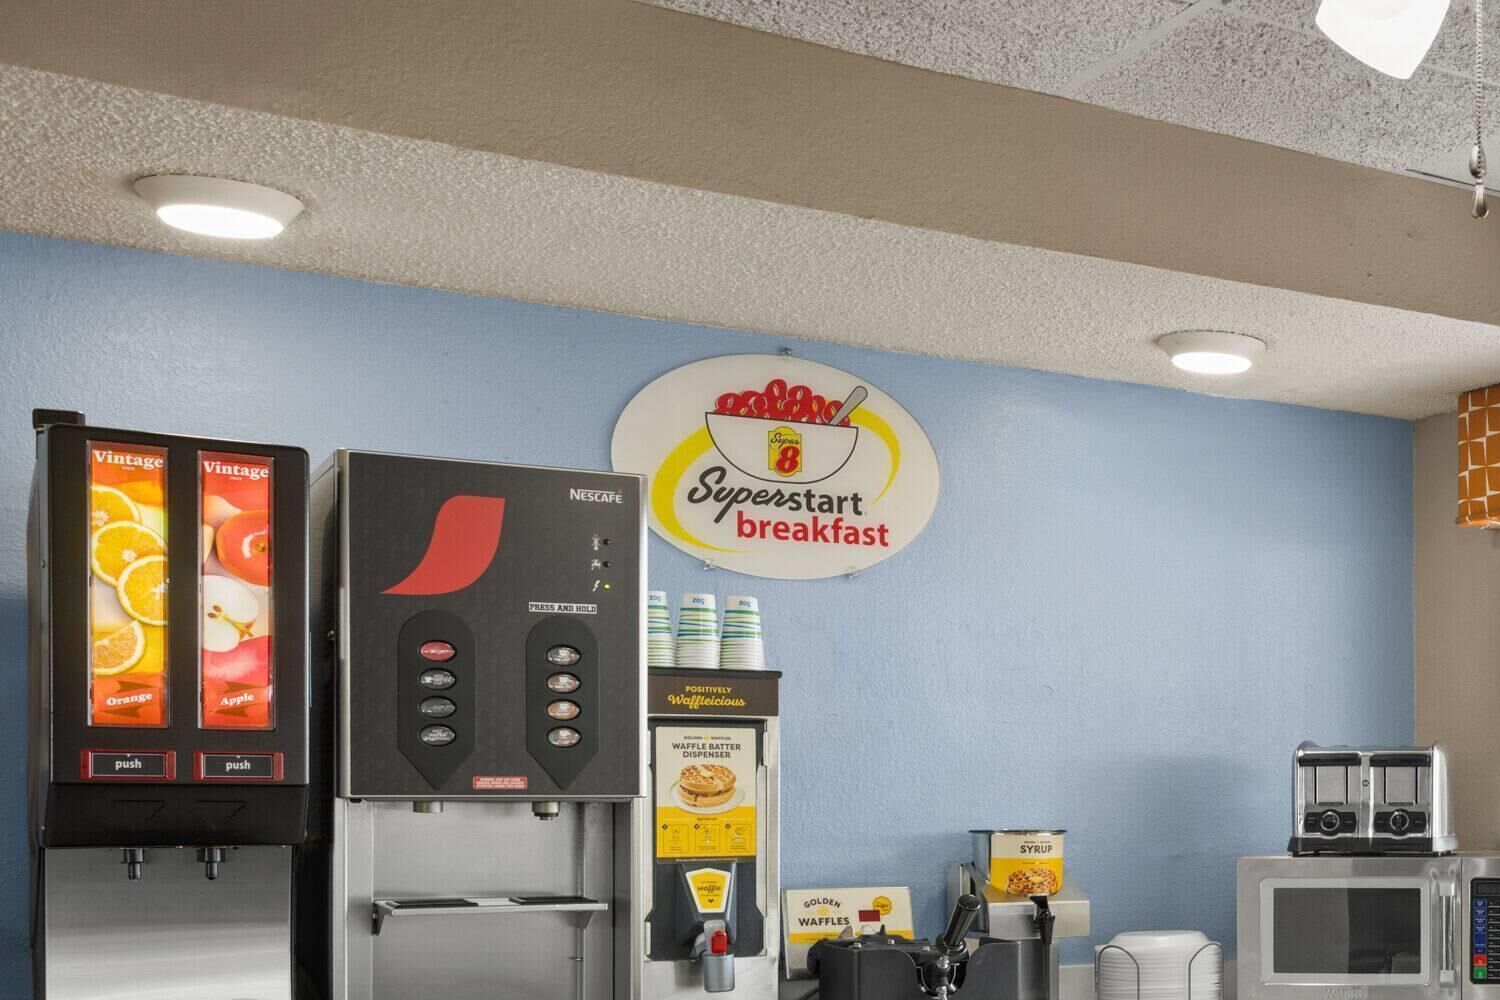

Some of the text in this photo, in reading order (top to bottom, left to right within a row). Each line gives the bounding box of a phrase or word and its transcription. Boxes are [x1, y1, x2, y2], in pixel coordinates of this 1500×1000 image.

[770, 432, 801, 449] Super
[93, 450, 164, 471] Vintage
[775, 445, 800, 473] 8
[203, 461, 270, 480] Vintage
[687, 466, 863, 525] Superstart
[736, 510, 889, 547] breakfast
[692, 597, 705, 605] 5oz
[738, 600, 752, 608] 5oz
[529, 603, 597, 613] PRESS AND HOLD
[685, 685, 732, 694] POSITIVELY
[106, 692, 153, 706] Orange
[220, 692, 255, 707] Apple
[667, 694, 746, 710] Waffleicious
[672, 742, 742, 751] WAFFLE BATTER
[682, 751, 731, 759] DISPENSER
[115, 758, 142, 771] push
[226, 760, 251, 772] push
[1020, 844, 1053, 854] SYRUP
[803, 897, 841, 909] GOLDEN
[798, 917, 850, 926] WAFFLES
